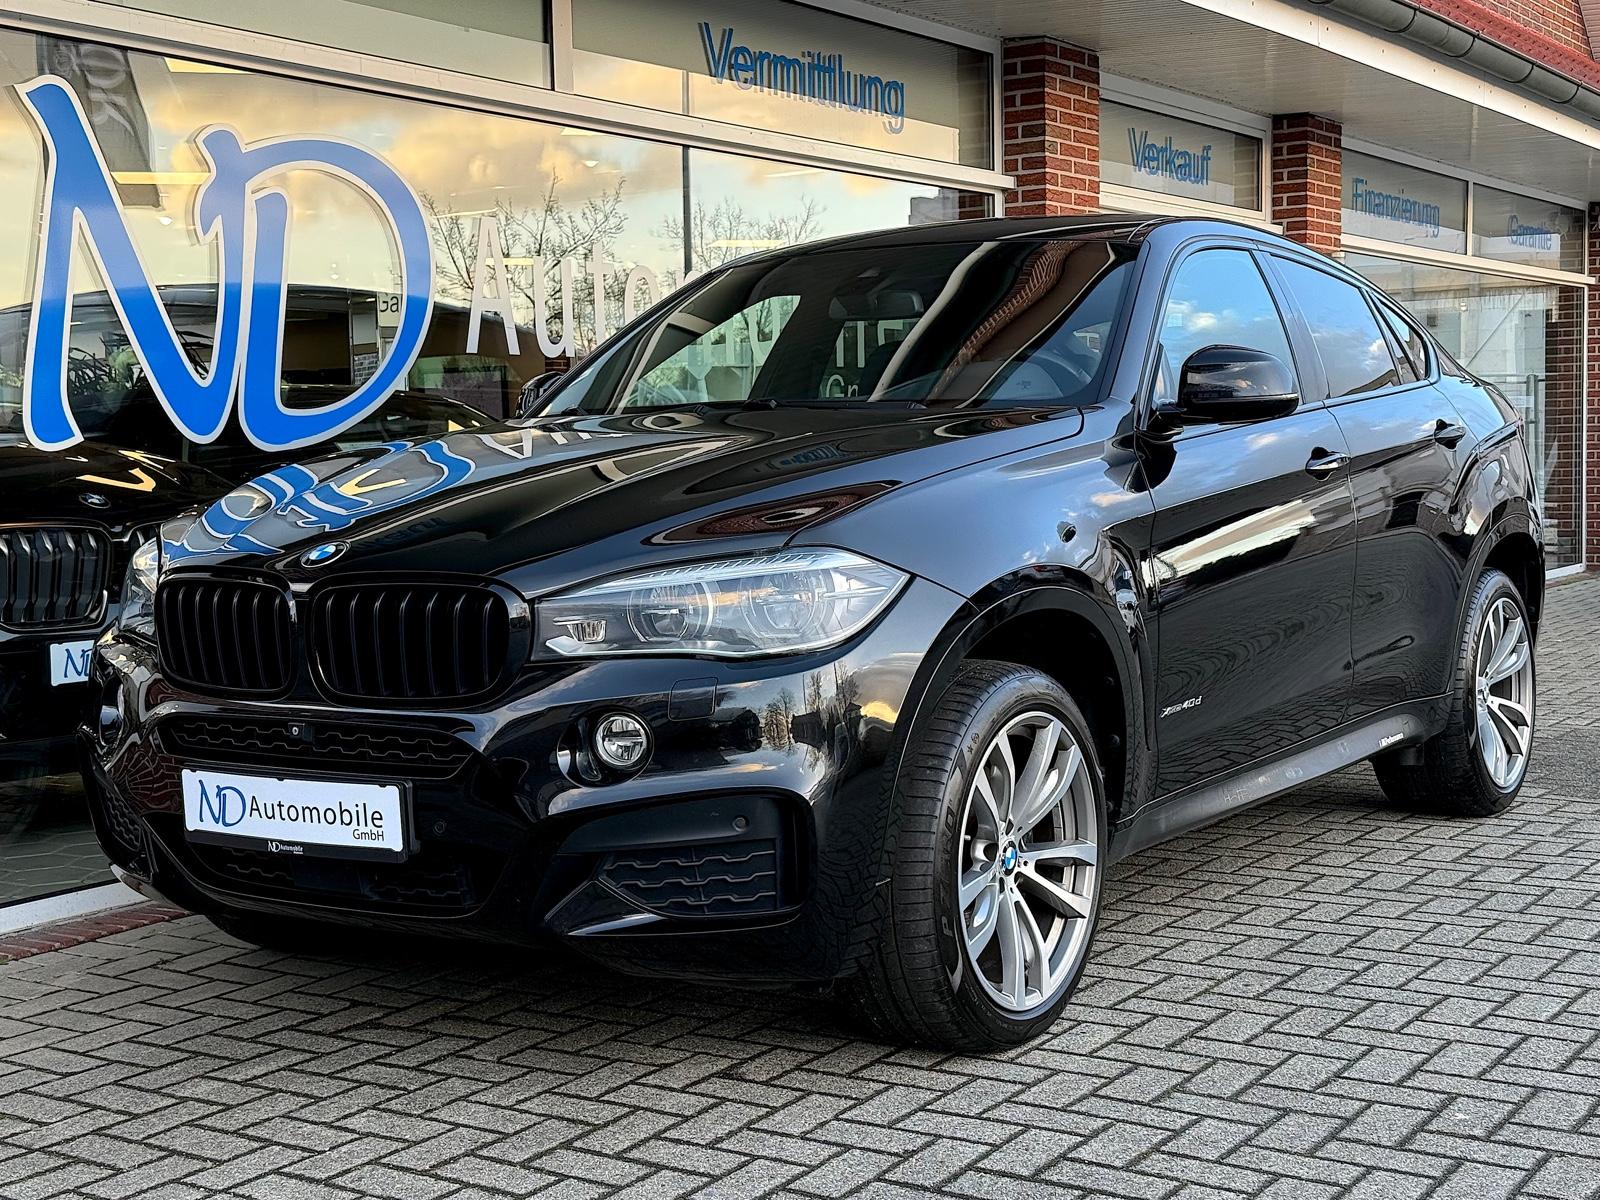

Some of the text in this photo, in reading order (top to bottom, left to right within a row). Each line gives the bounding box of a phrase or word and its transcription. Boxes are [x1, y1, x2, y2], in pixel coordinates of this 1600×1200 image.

[700, 21, 905, 134] Vermittlung
[1129, 127, 1212, 186] Verkauf
[1353, 178, 1440, 239] Finanzierung
[1508, 214, 1552, 250] Garantie
[14, 76, 435, 451] ND
[198, 779, 384, 829] ND Automobile
[352, 828, 385, 842] GmbH
